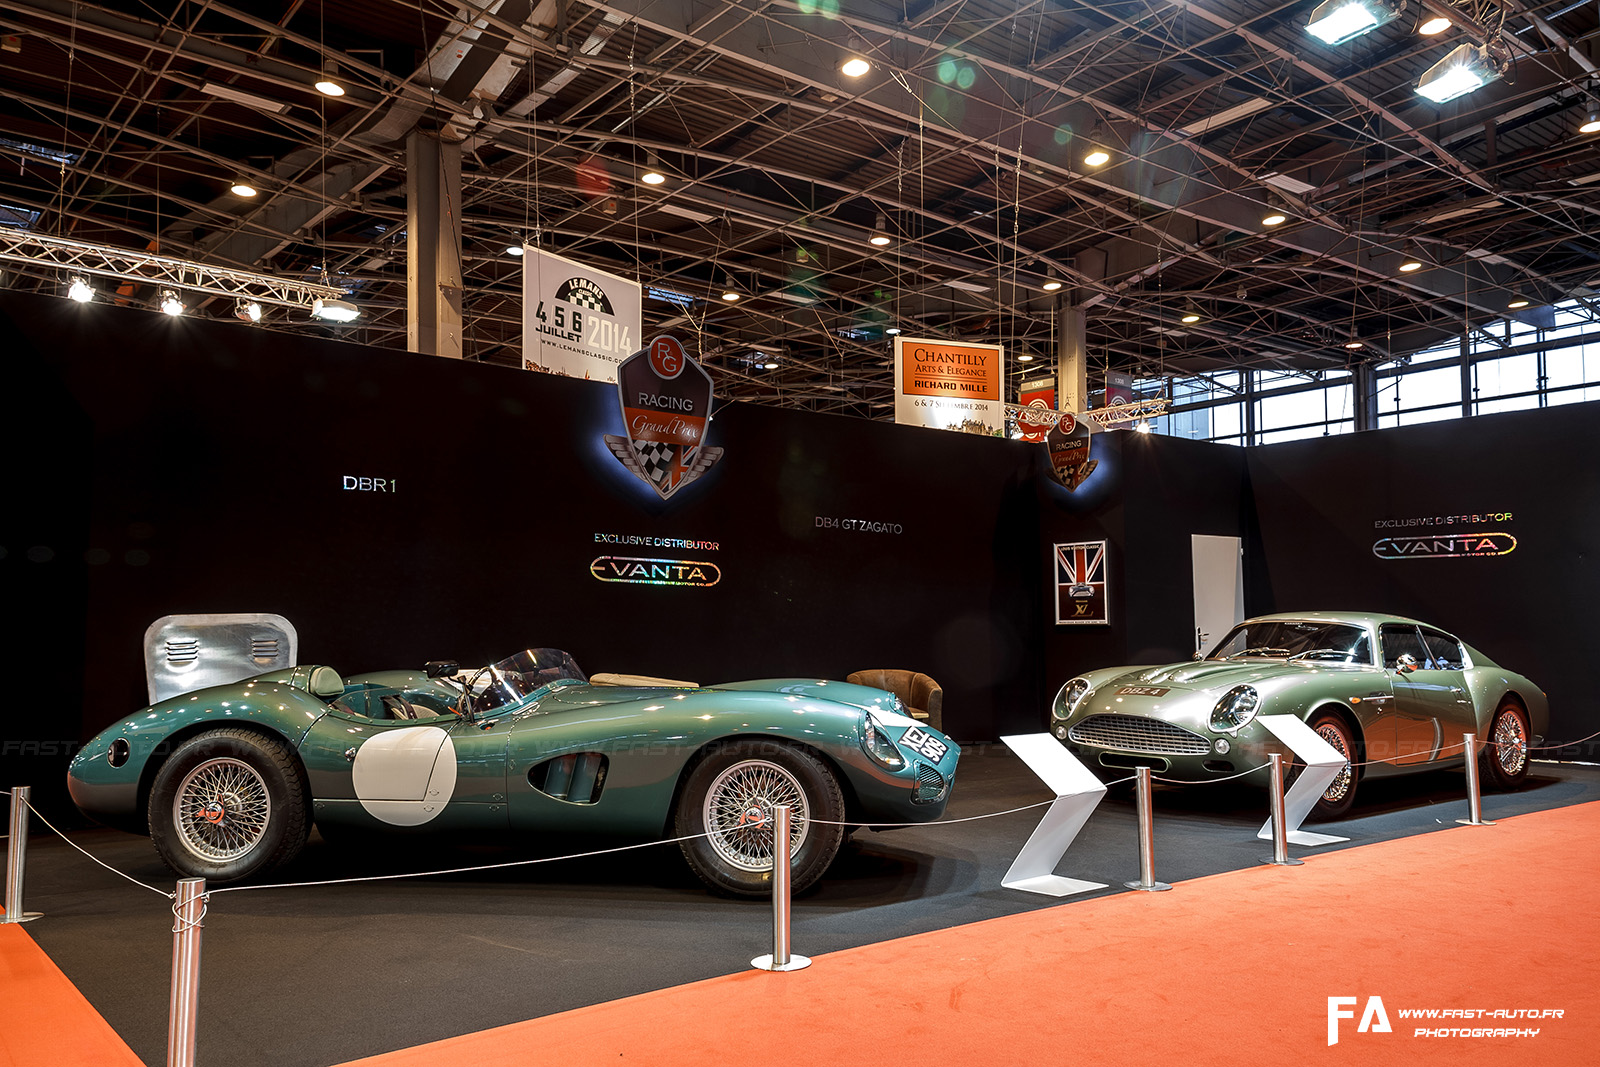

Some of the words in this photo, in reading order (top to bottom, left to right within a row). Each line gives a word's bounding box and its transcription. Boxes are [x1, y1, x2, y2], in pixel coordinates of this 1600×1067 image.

[536, 300, 547, 323] 4
[555, 306, 565, 328] 5
[573, 311, 582, 333] 6
[535, 324, 582, 343] JUILLET
[588, 316, 632, 356] 2014
[914, 348, 987, 366] CHANTILLY
[915, 364, 936, 374] ARTS
[938, 366, 944, 374] &
[947, 366, 987, 377] ELEGANCE
[914, 380, 957, 390] RICHARD
[960, 383, 988, 393] MILLE
[638, 391, 694, 412] RACING
[914, 399, 920, 407] 6
[974, 403, 989, 411] 2014
[632, 414, 674, 437] Grand
[671, 416, 700, 439] Prix
[343, 475, 396, 493] DBR1
[815, 516, 840, 529] DB4
[841, 518, 858, 530] GT
[859, 519, 903, 535] ZAGATO
[1374, 518, 1434, 529] EXCLUSIVE
[1435, 512, 1513, 526] DISTRIBUTOR
[594, 533, 653, 546] EXCLUSIVE
[654, 537, 720, 551] DISTRIBUTOR
[1373, 537, 1499, 558] EVANTA
[590, 556, 708, 581] EVANTA
